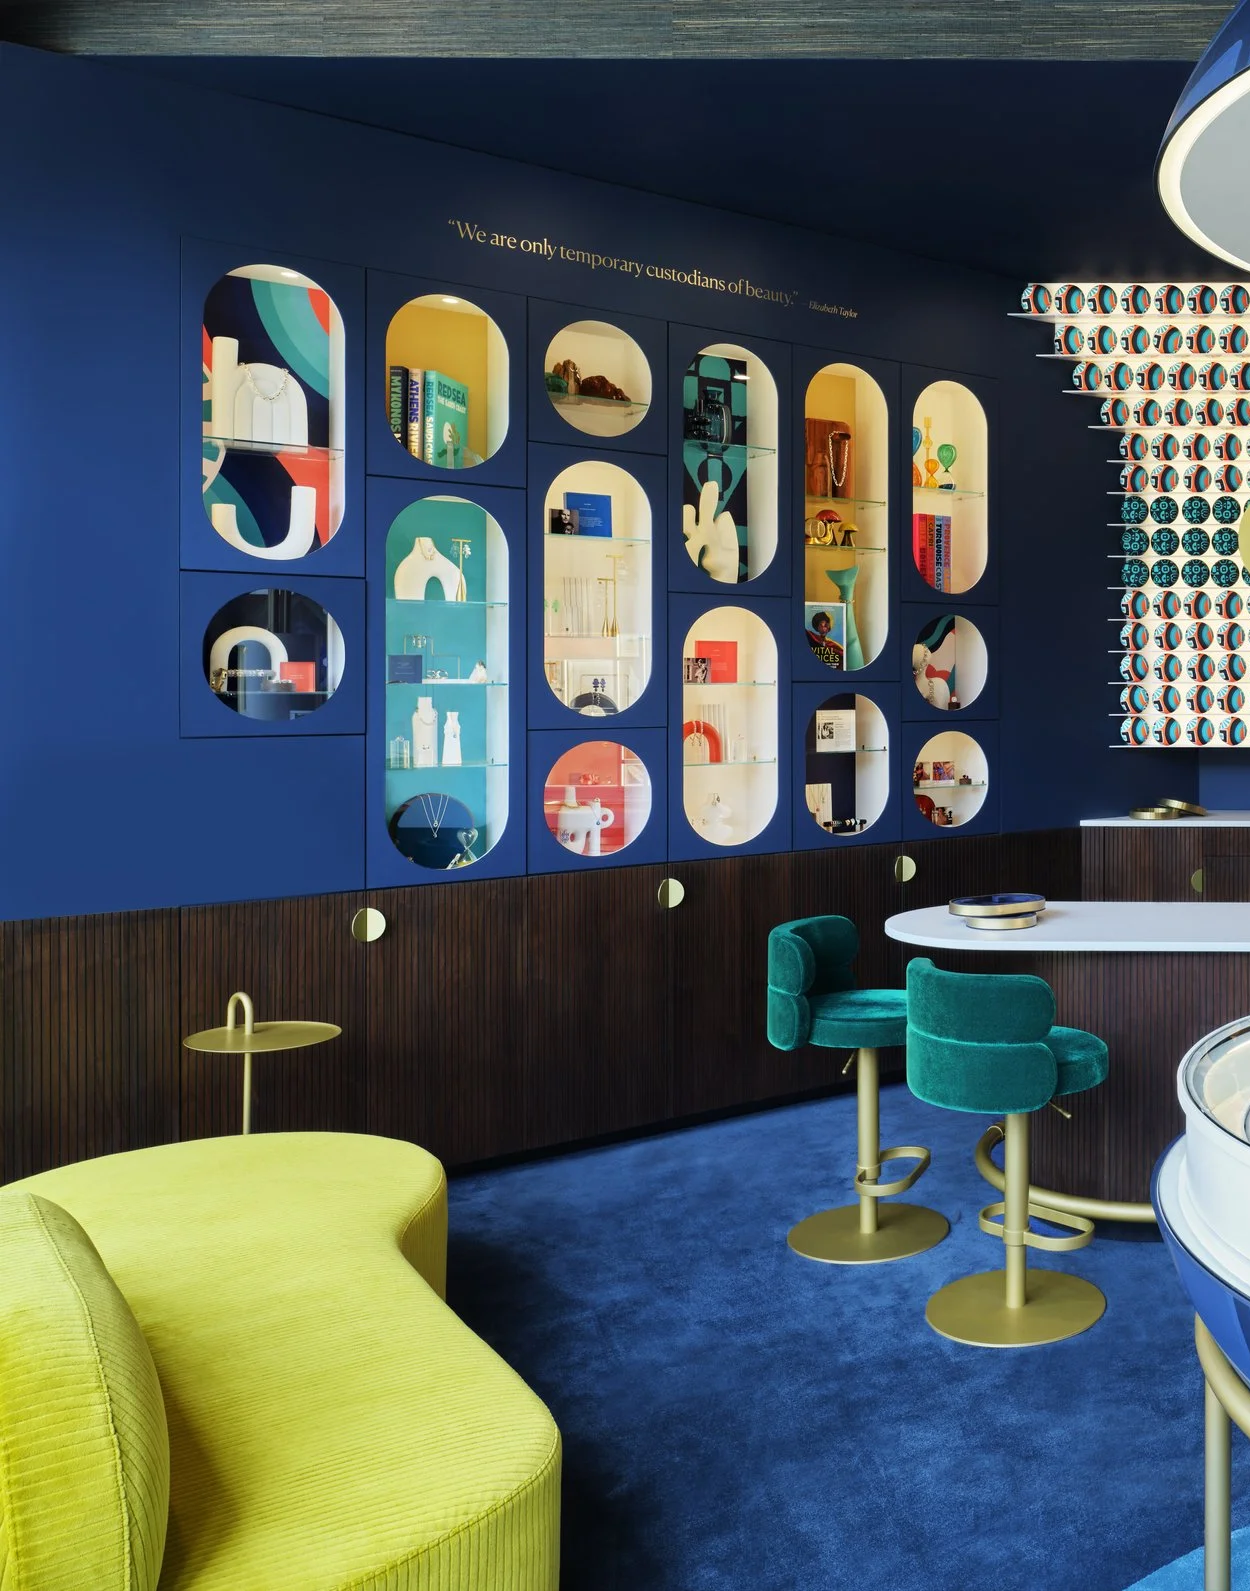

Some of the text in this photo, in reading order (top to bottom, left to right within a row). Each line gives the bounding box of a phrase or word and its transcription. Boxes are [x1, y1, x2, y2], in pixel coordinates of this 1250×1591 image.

[490, 233, 517, 249] are
[520, 237, 557, 260] only
[560, 245, 644, 278] temporary
[646, 265, 726, 291] custodians
[728, 278, 744, 295] of
[808, 300, 858, 318] Elizabeth Taylor
[426, 381, 434, 399] RED
[438, 380, 466, 407] RED SEA
[390, 375, 402, 434] MYKONOS
[426, 399, 434, 417] SEA
[409, 379, 419, 458] ATHENS RIVIE
[426, 416, 434, 442] SAUDI
[811, 647, 835, 655] VITAL
